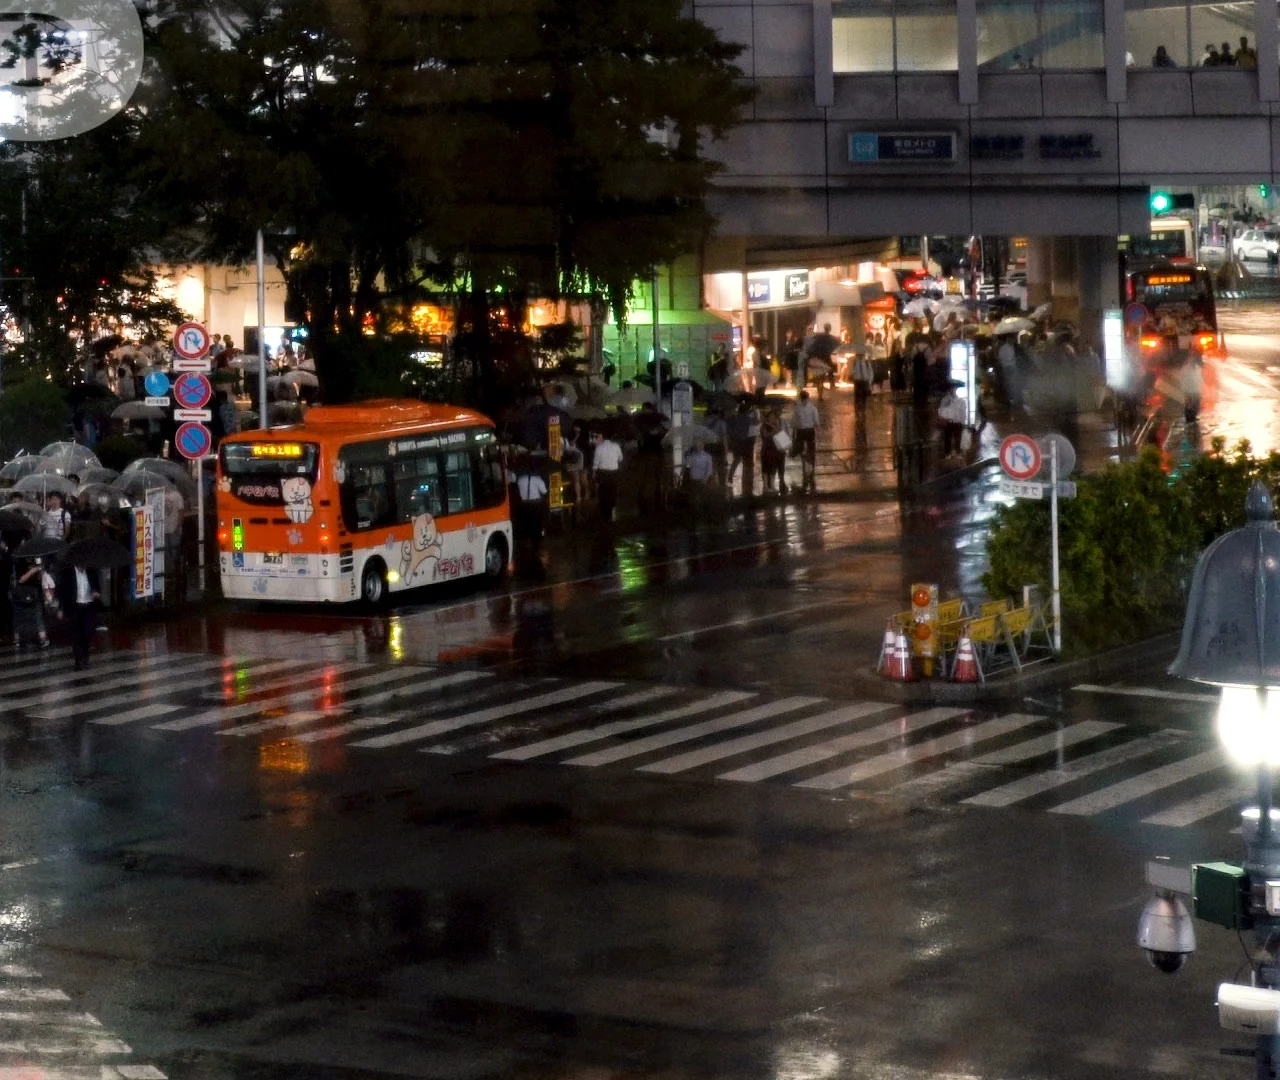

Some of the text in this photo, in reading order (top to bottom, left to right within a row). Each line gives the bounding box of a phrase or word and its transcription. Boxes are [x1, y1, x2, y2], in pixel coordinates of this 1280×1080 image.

[1002, 483, 1038, 496] ここまで
[143, 512, 154, 591] バス停につき
